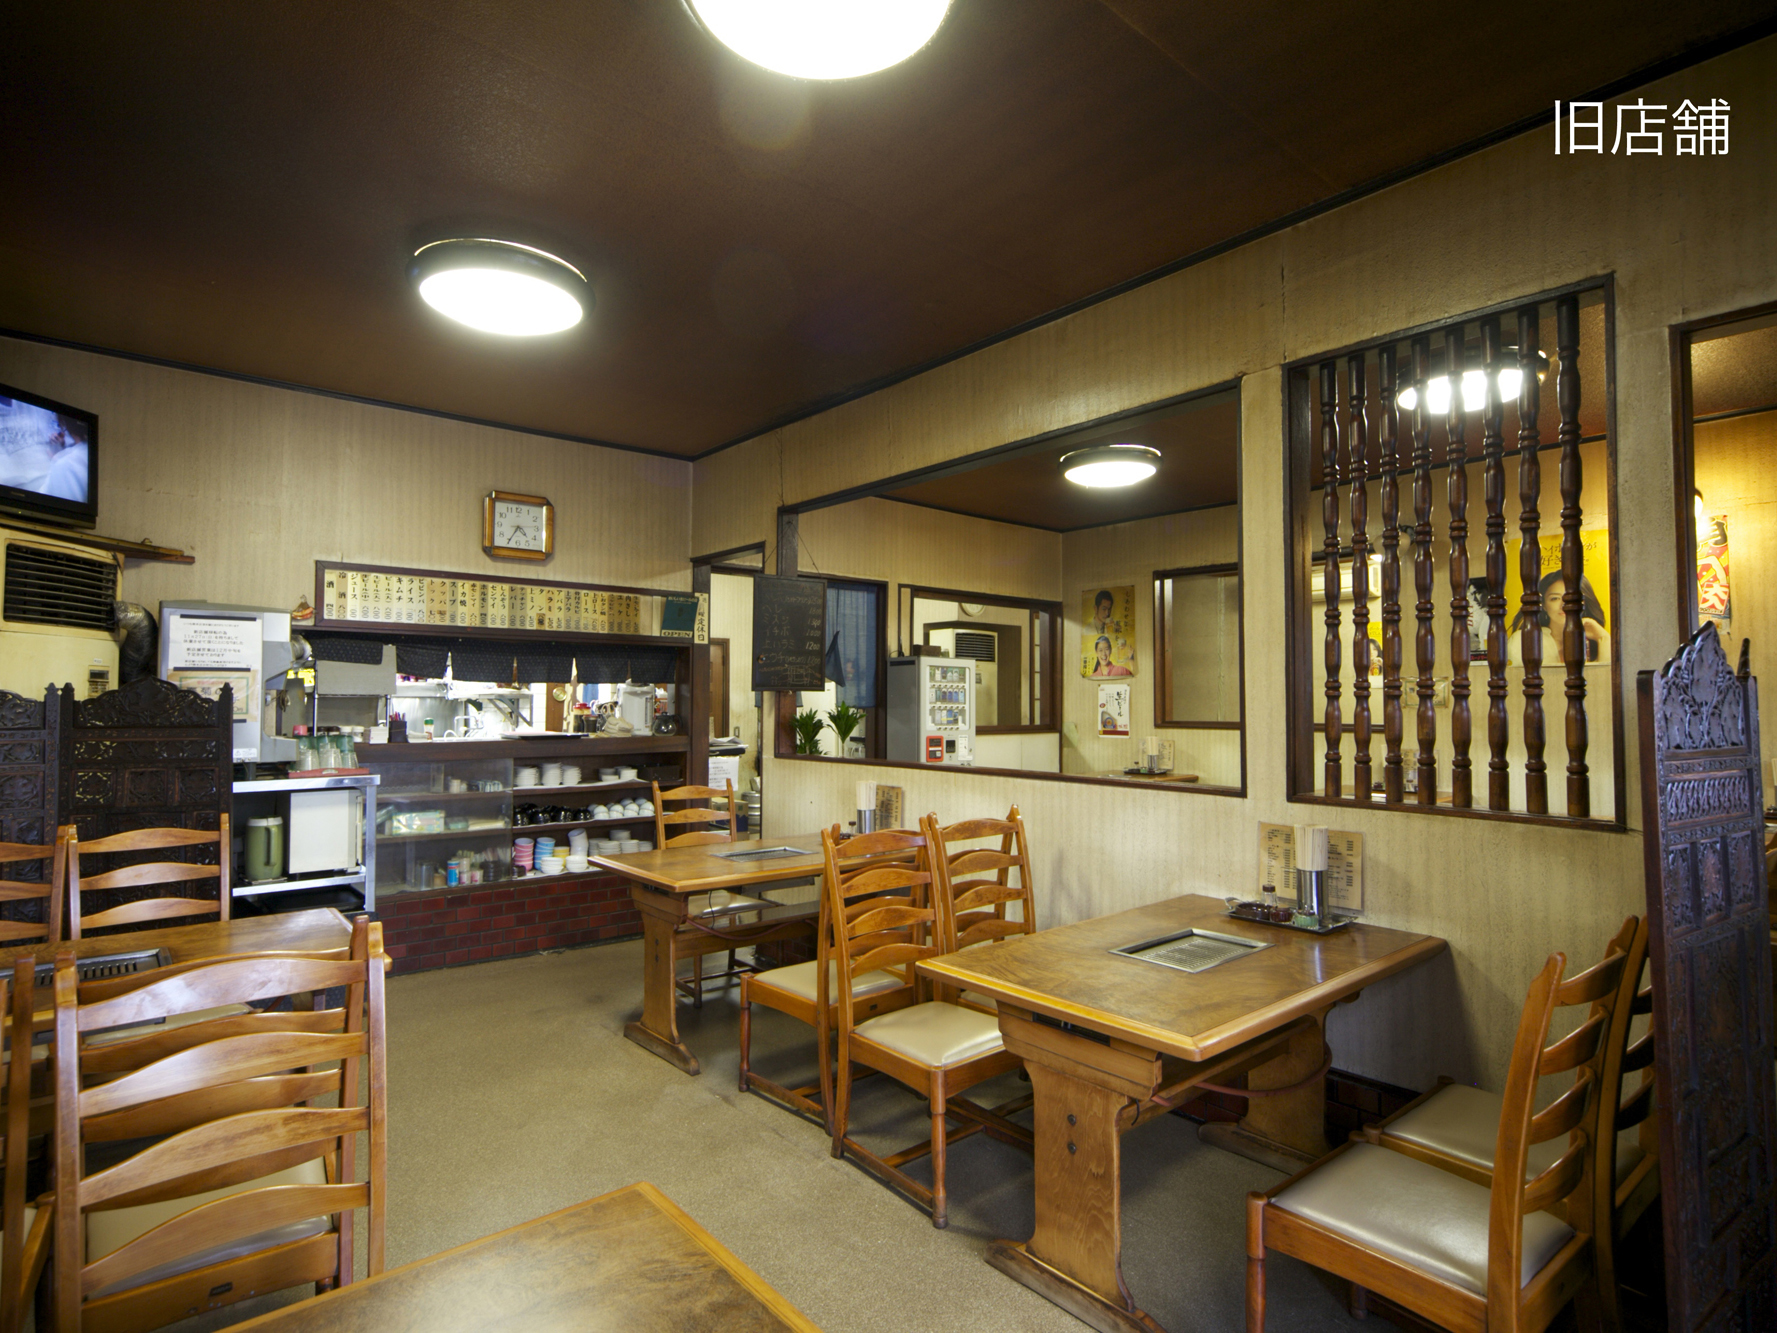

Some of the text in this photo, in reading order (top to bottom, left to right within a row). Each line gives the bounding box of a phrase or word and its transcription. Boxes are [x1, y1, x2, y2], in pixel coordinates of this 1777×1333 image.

[763, 615, 789, 625] ミスジ
[805, 642, 820, 650] 1200
